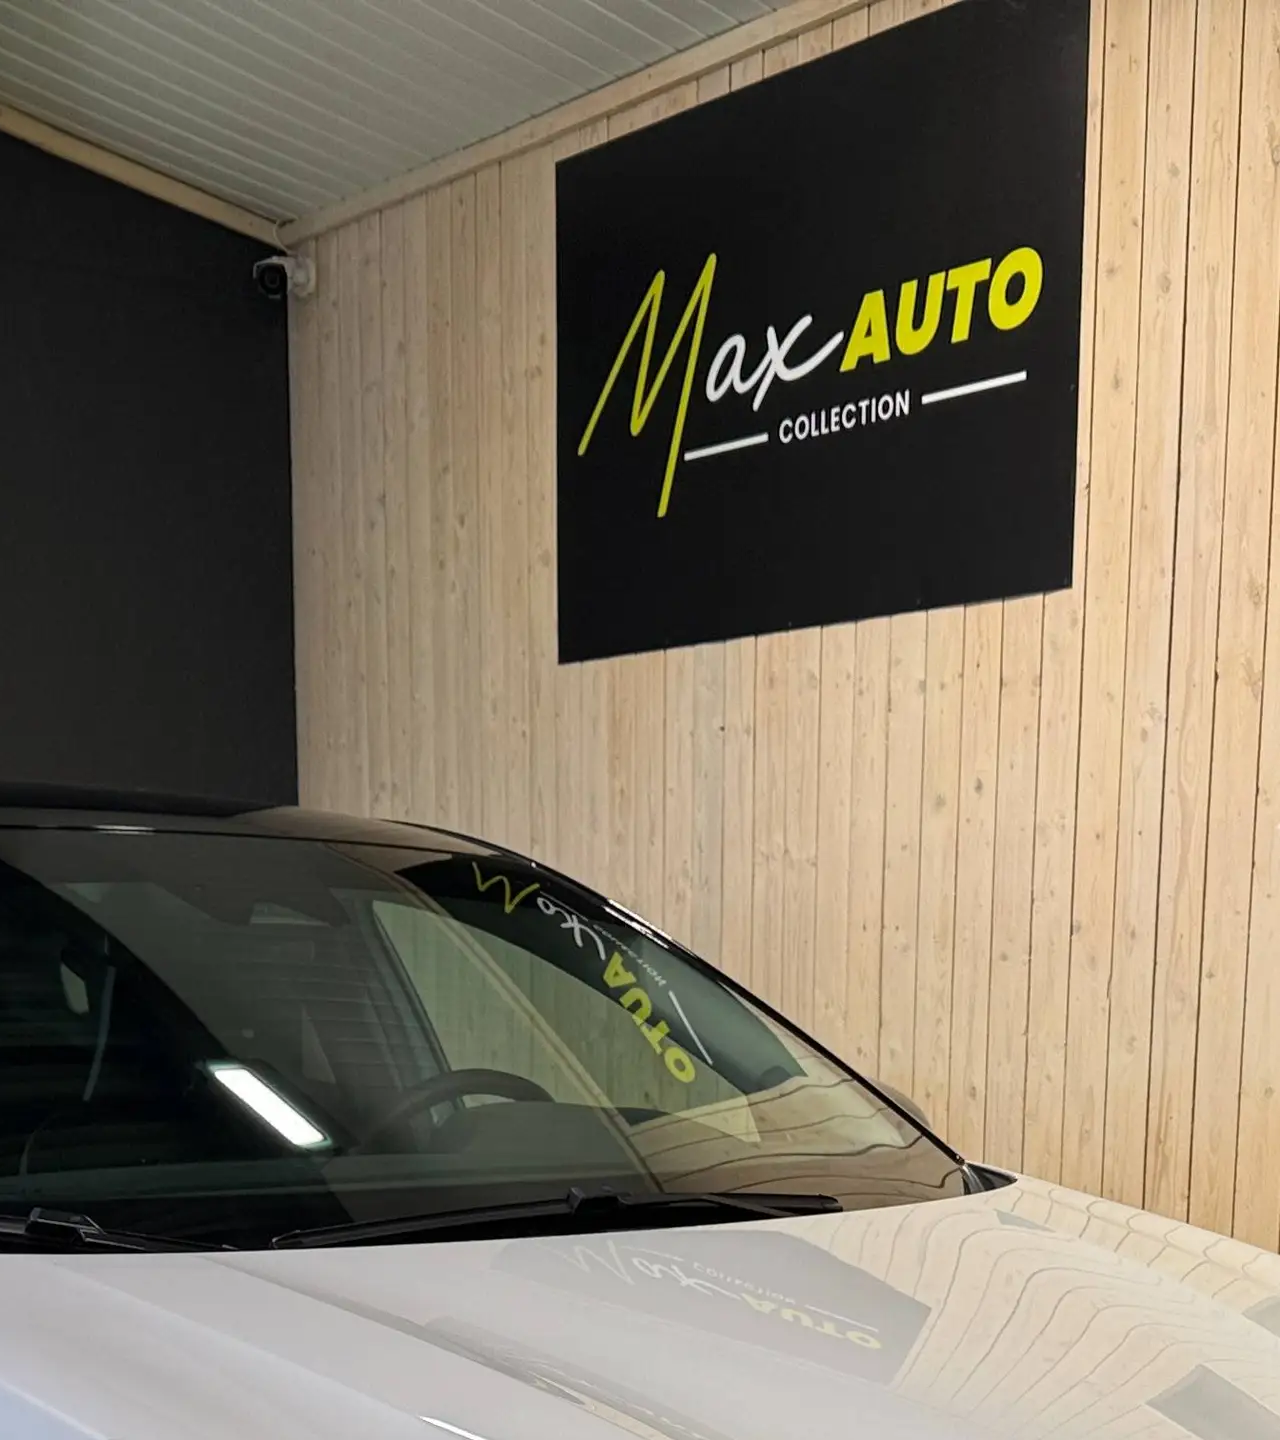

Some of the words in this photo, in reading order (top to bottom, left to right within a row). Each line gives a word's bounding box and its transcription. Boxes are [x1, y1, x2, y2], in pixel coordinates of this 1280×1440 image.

[577, 252, 845, 518] Max
[839, 246, 1044, 373] AUTO
[778, 389, 911, 444] COLLECTION
